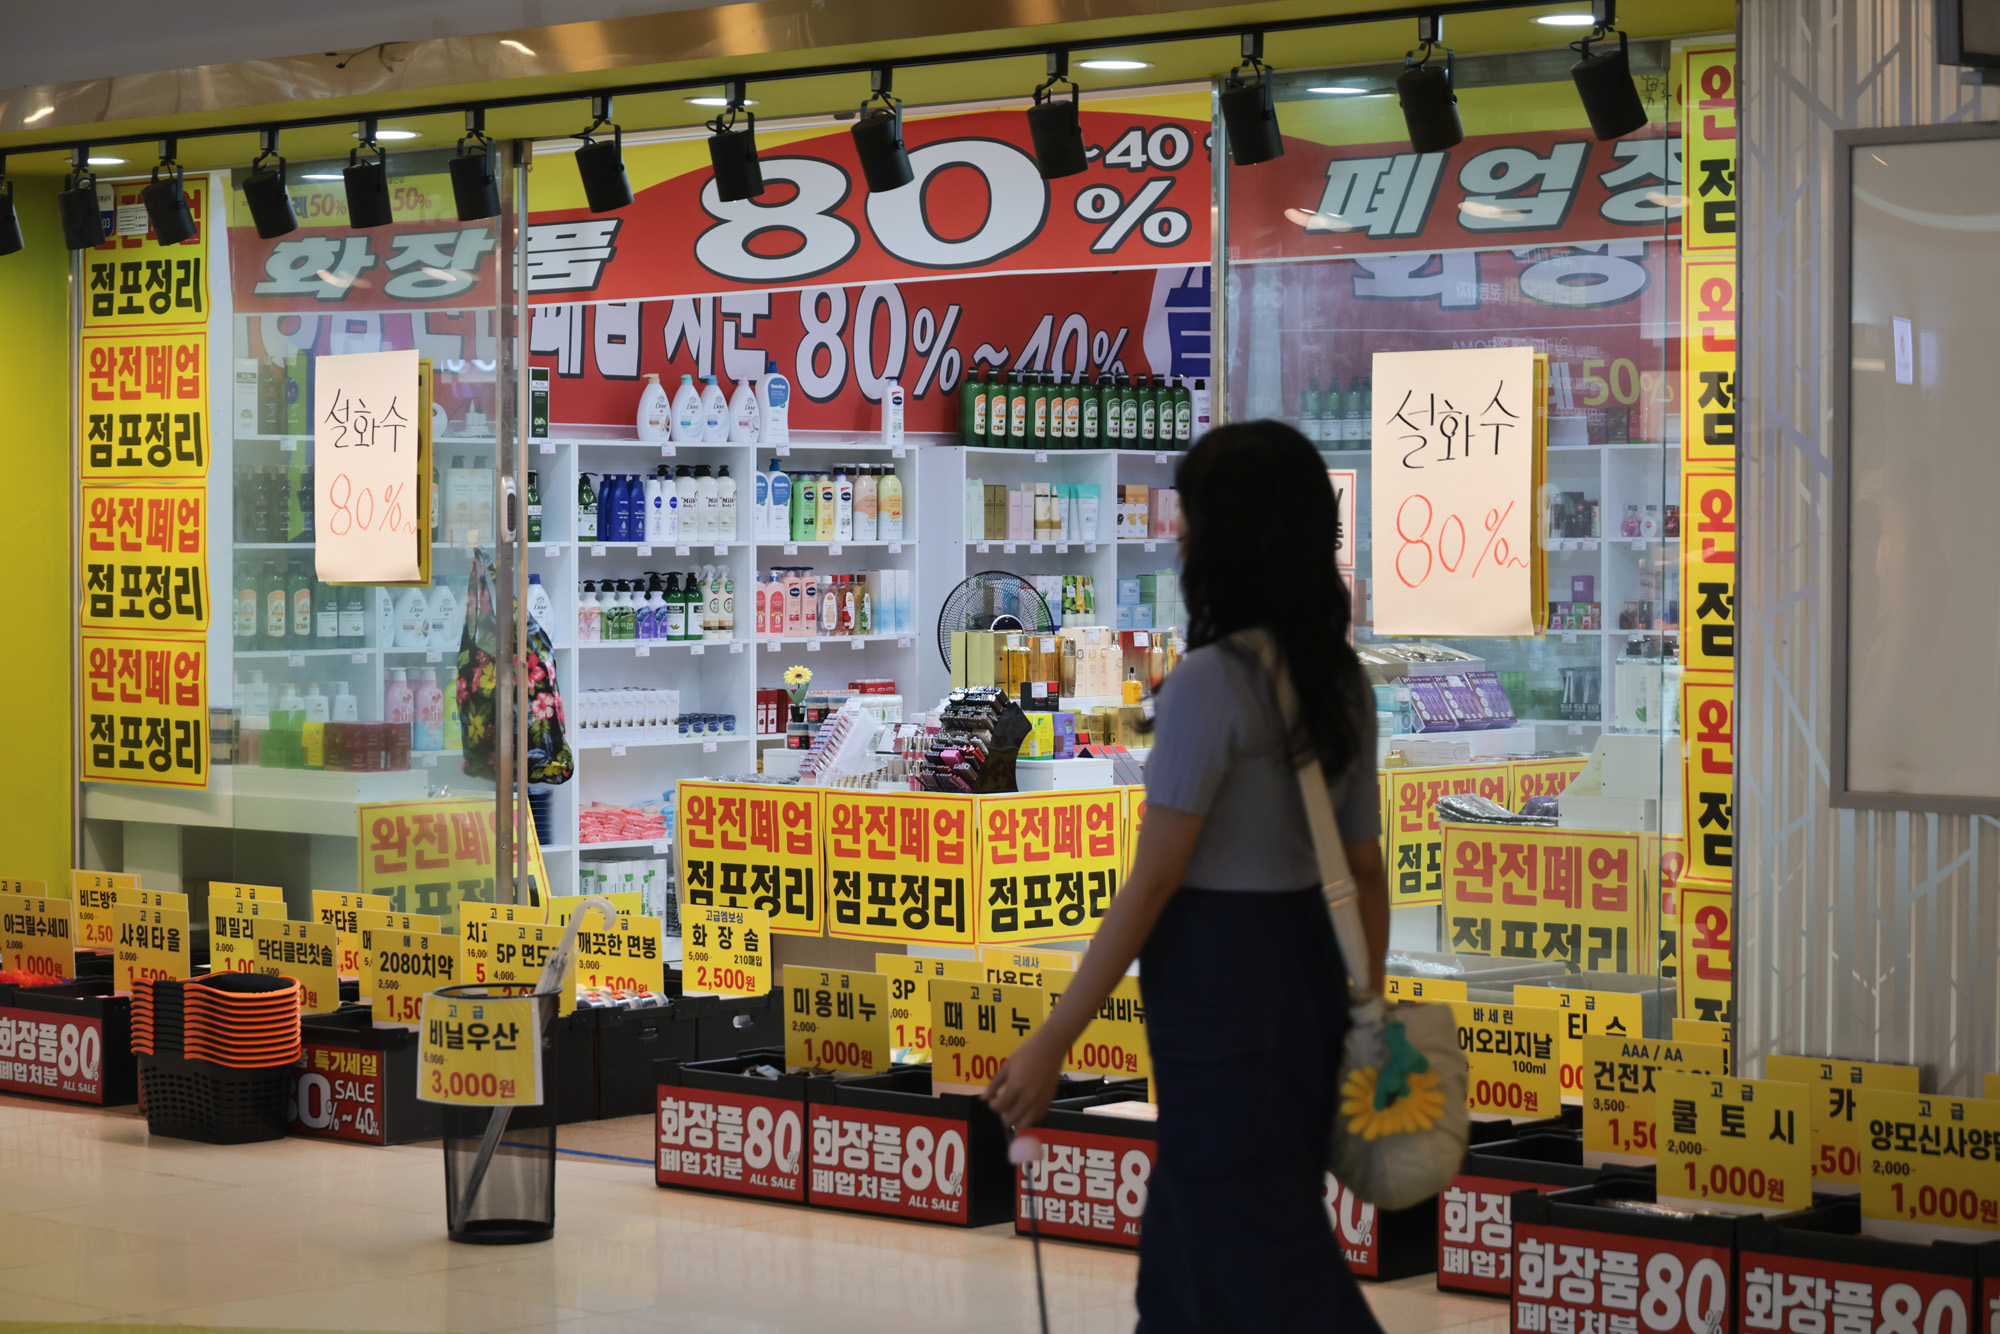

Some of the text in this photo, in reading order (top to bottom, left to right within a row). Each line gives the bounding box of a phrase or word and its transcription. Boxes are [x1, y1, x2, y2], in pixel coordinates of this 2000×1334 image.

[309, 193, 347, 218] 50%
[392, 186, 432, 212] 50%
[694, 135, 1050, 296] 80
[90, 258, 202, 317] 점포정리
[89, 343, 200, 401] 완전폐업
[324, 388, 408, 452] 설화수
[1386, 379, 1520, 469] 설화수
[88, 412, 203, 467] 점포정리
[88, 497, 200, 553] 완전폐업
[87, 563, 203, 621] 점포정리
[89, 647, 200, 707] 완전폐업
[89, 713, 201, 774] 점포정리
[686, 795, 813, 855] 완전폐업
[831, 803, 965, 865] 완전폐업
[988, 802, 1115, 865] 완전폐업
[687, 859, 813, 921] 점포정리
[1453, 840, 1628, 912] 완전폐업
[833, 870, 965, 933] 점포정리
[988, 868, 1116, 933] 점포정리
[4, 913, 69, 939] 아크릴수세미
[705, 910, 743, 924] 고급엠보싱
[6, 940, 23, 950] 2,000
[120, 923, 180, 953] 샤워타올
[215, 942, 234, 953] 2,000
[578, 931, 656, 959] 깨끗한 면봉
[14, 954, 63, 978] 1000원
[119, 951, 137, 962] 3,000
[258, 939, 333, 967] 닥터클린칫솔
[380, 951, 454, 980] 2080치약
[496, 943, 516, 964] 5P
[579, 960, 600, 970] 3,000
[688, 951, 762, 967] 5,000 210매입
[1013, 955, 1039, 968] 극세사
[378, 980, 399, 990] 2,500
[494, 971, 515, 981] 4,000
[589, 974, 648, 994] 1500원
[697, 966, 755, 992] 2,500원
[892, 979, 916, 1000] 3P
[793, 987, 876, 1022] 미용비누
[890, 1008, 909, 1019] ,000
[1473, 1007, 1513, 1025] 바세린
[429, 1019, 519, 1051] 비닐우산
[792, 1021, 817, 1033] 2,000
[939, 1035, 966, 1047] 2,000
[0, 1016, 100, 1082] 화장품 80%
[804, 1038, 873, 1069] 1,000원
[1067, 1042, 1138, 1073] 1,000원
[1621, 1043, 1649, 1059] AAA
[1664, 1047, 1683, 1063] AA
[0, 1060, 58, 1087] 폐업처분
[315, 1050, 378, 1078] 특가세일
[1512, 1060, 1546, 1075] 100ml
[63, 1080, 97, 1094] ALL SALE
[334, 1079, 375, 1104] SALE
[431, 1069, 516, 1099] 3,000원
[1470, 1079, 1538, 1112] ,000원
[1593, 1098, 1625, 1113] 3,500
[660, 1096, 802, 1177] 화장품 80%
[1667, 1139, 1702, 1156] 2,000
[660, 1147, 743, 1181] 폐업처분
[812, 1115, 966, 1198] 화장품 80%
[1873, 1159, 1910, 1176] 2,000
[749, 1173, 796, 1191] ALL SALE
[812, 1168, 902, 1203] 폐업처분
[1117, 1149, 1150, 1218] 8
[1684, 1162, 1785, 1203] 1,000원
[909, 1195, 960, 1212] ALL SALE
[1020, 1194, 1117, 1230] 폐업처분
[1891, 1182, 1998, 1224] 1,000원
[1344, 1249, 1368, 1264] ALE
[1517, 1237, 1727, 1334] 화장품 80%
[1745, 1266, 1875, 1334] 화장품
